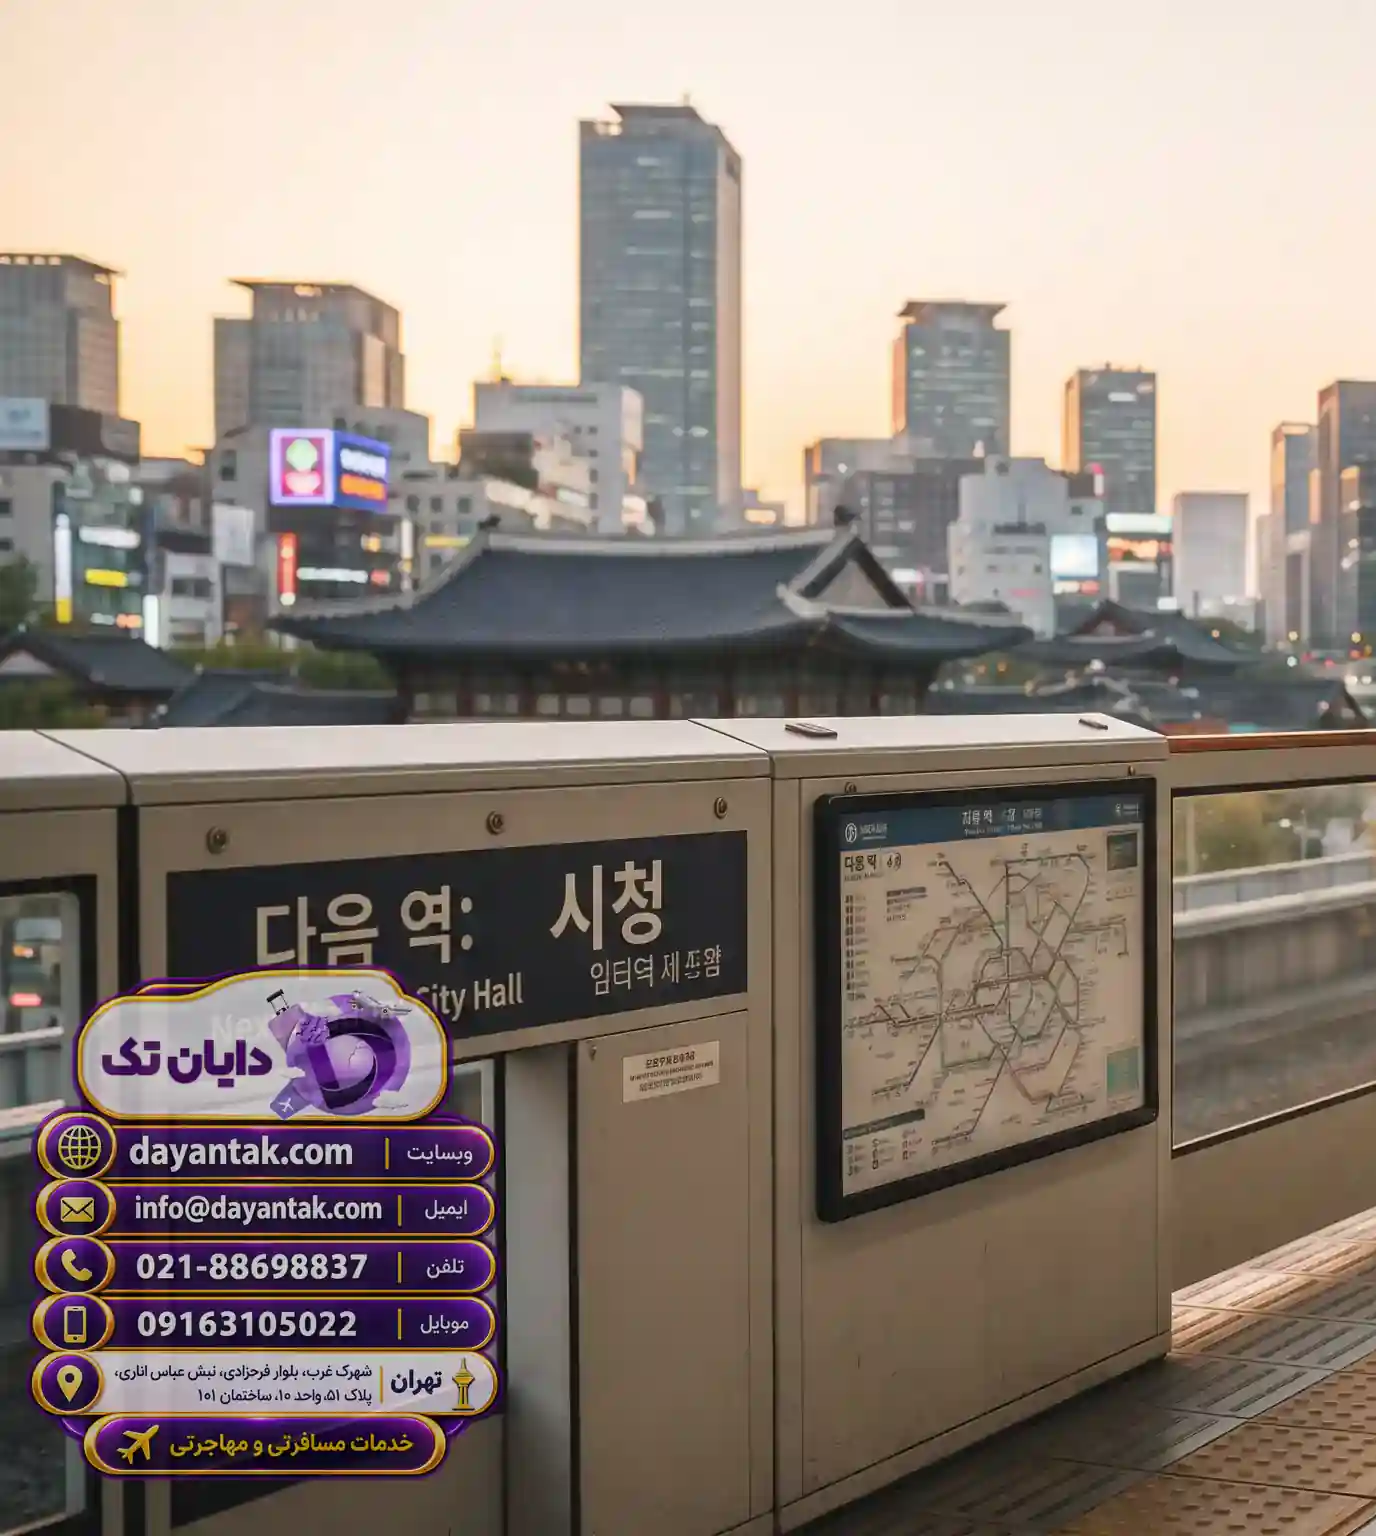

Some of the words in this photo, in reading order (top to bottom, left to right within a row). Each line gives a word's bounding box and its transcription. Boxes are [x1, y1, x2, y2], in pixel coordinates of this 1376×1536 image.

[256, 892, 380, 967] 다음
[400, 884, 474, 964] 역:
[549, 859, 665, 950] 시청
[473, 971, 524, 1011] Hall
